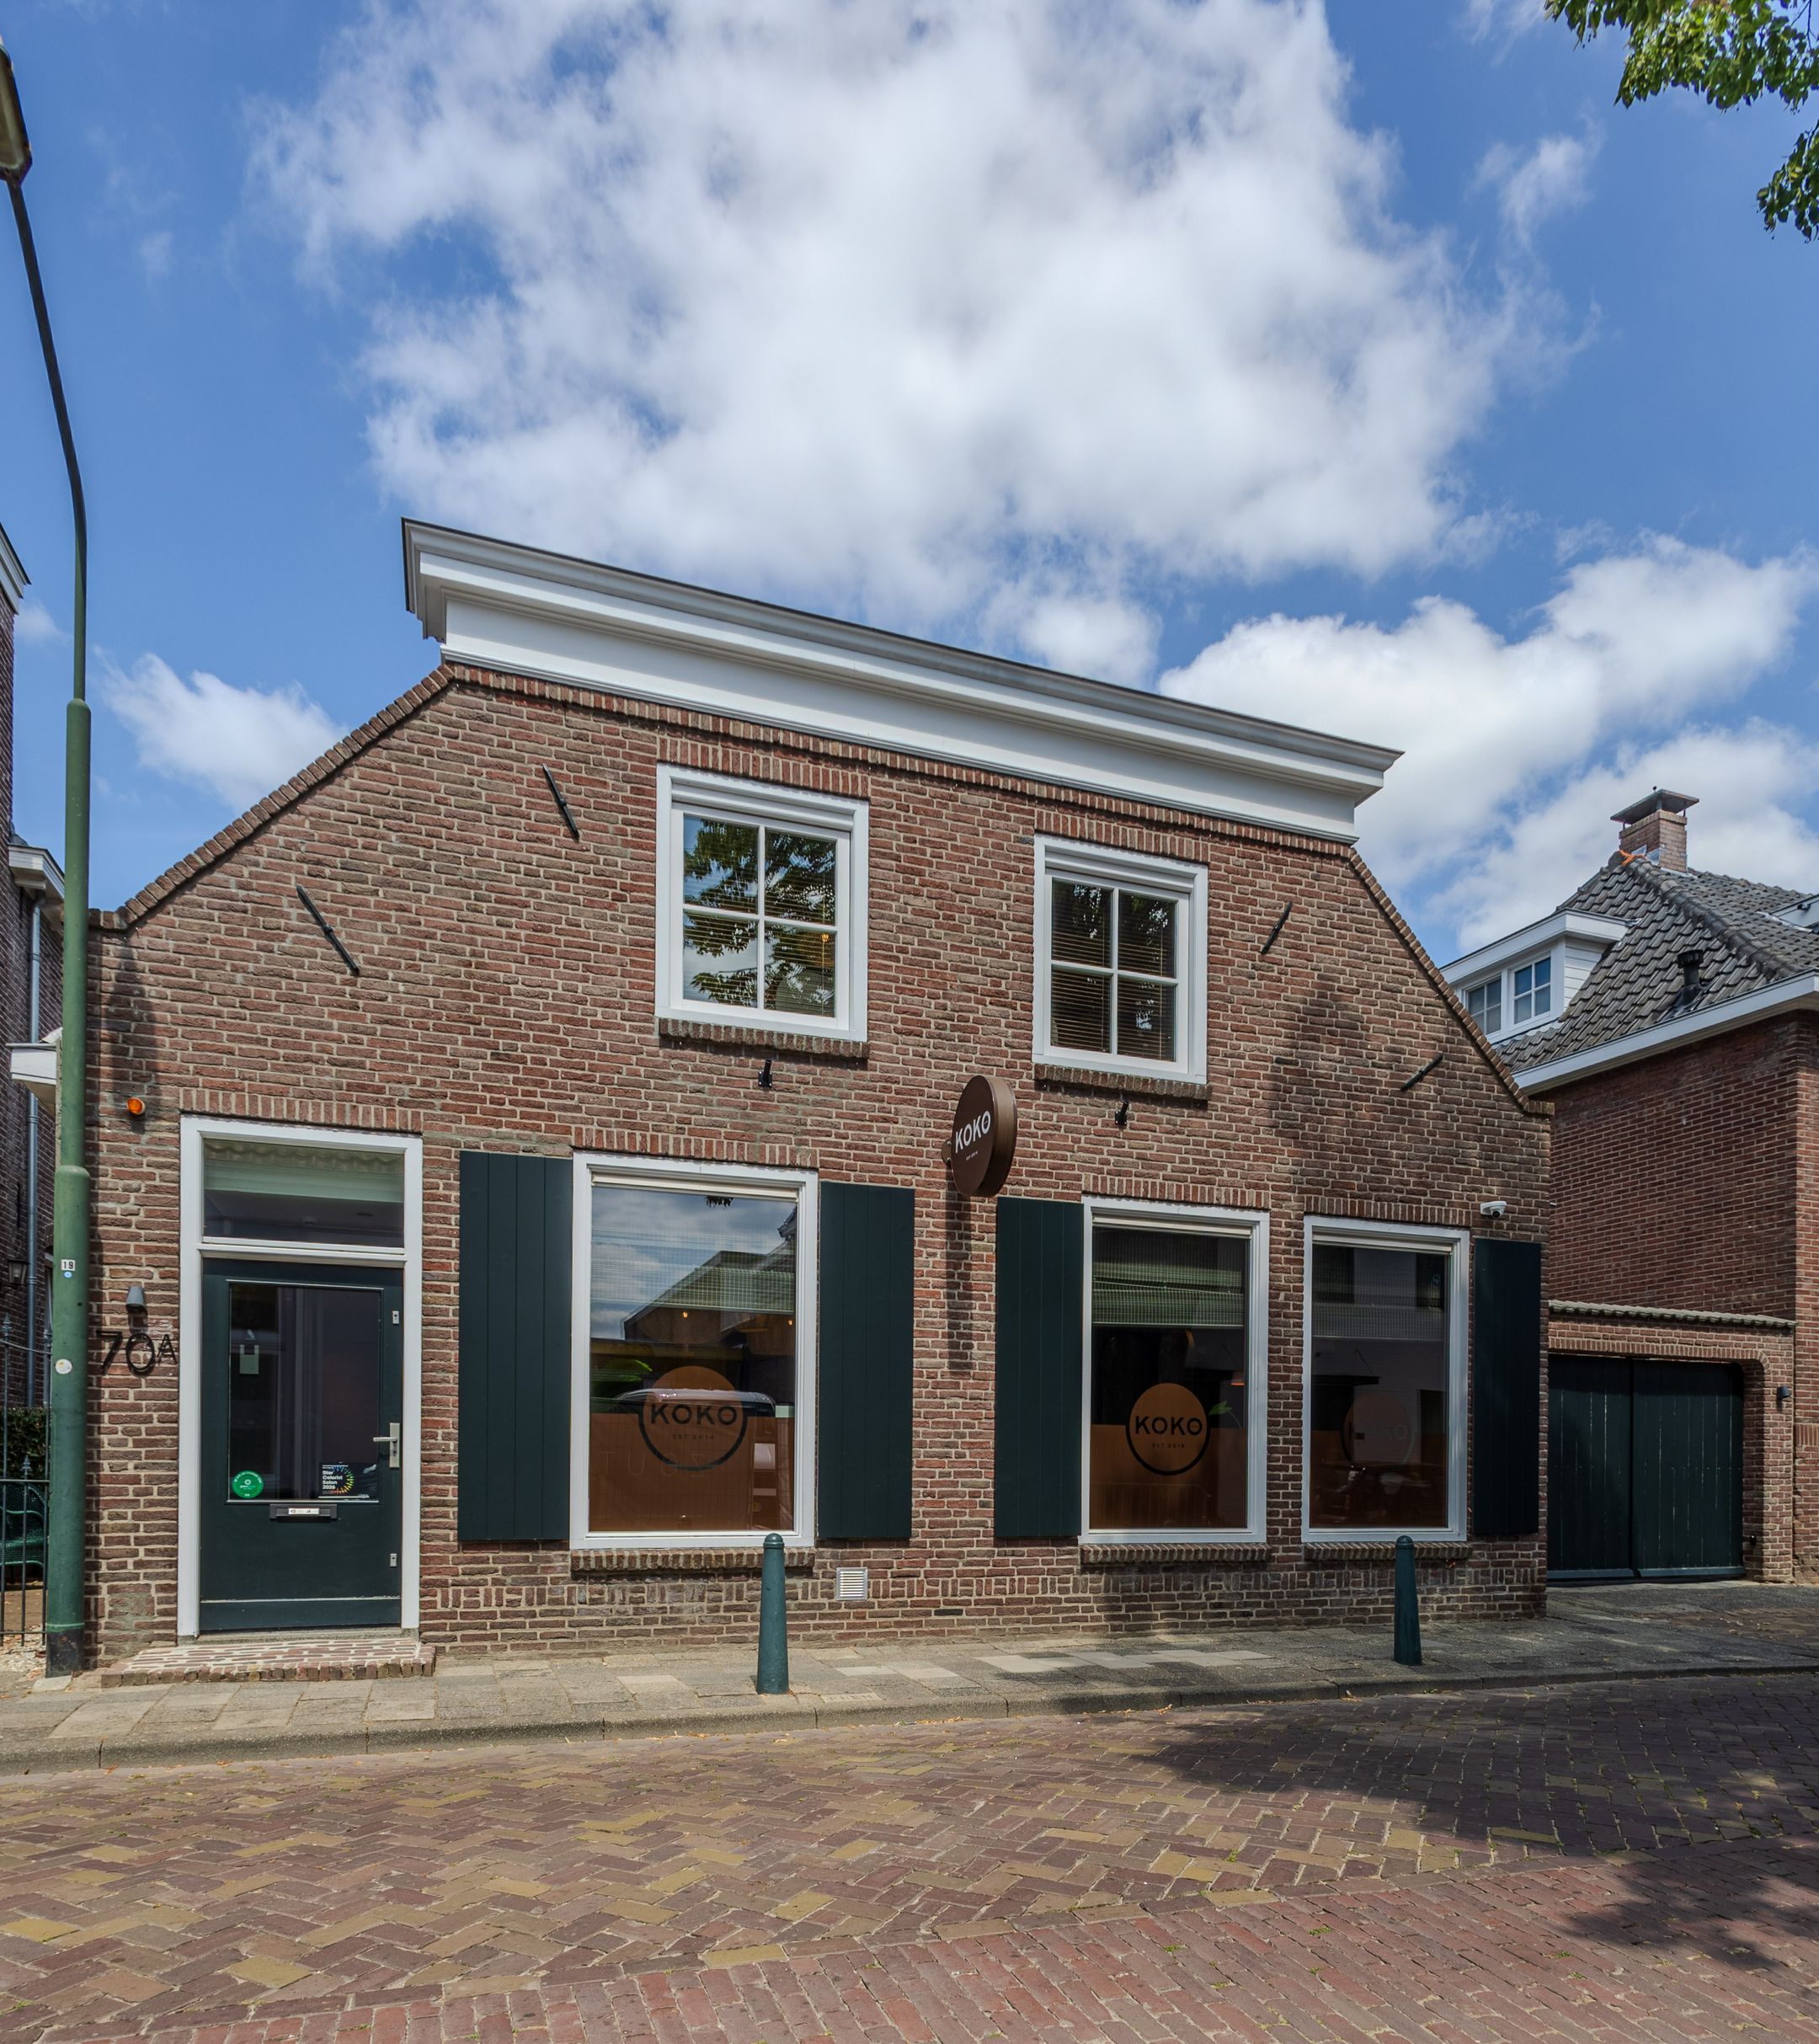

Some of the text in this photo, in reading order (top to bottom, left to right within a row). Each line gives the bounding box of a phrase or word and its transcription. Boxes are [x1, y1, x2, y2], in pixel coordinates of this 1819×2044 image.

[955, 1110, 991, 1154] KOKO
[63, 1261, 74, 1270] 19
[96, 1331, 177, 1374] 70A
[650, 1403, 738, 1425] KOKO
[1134, 1416, 1203, 1436] KOKO
